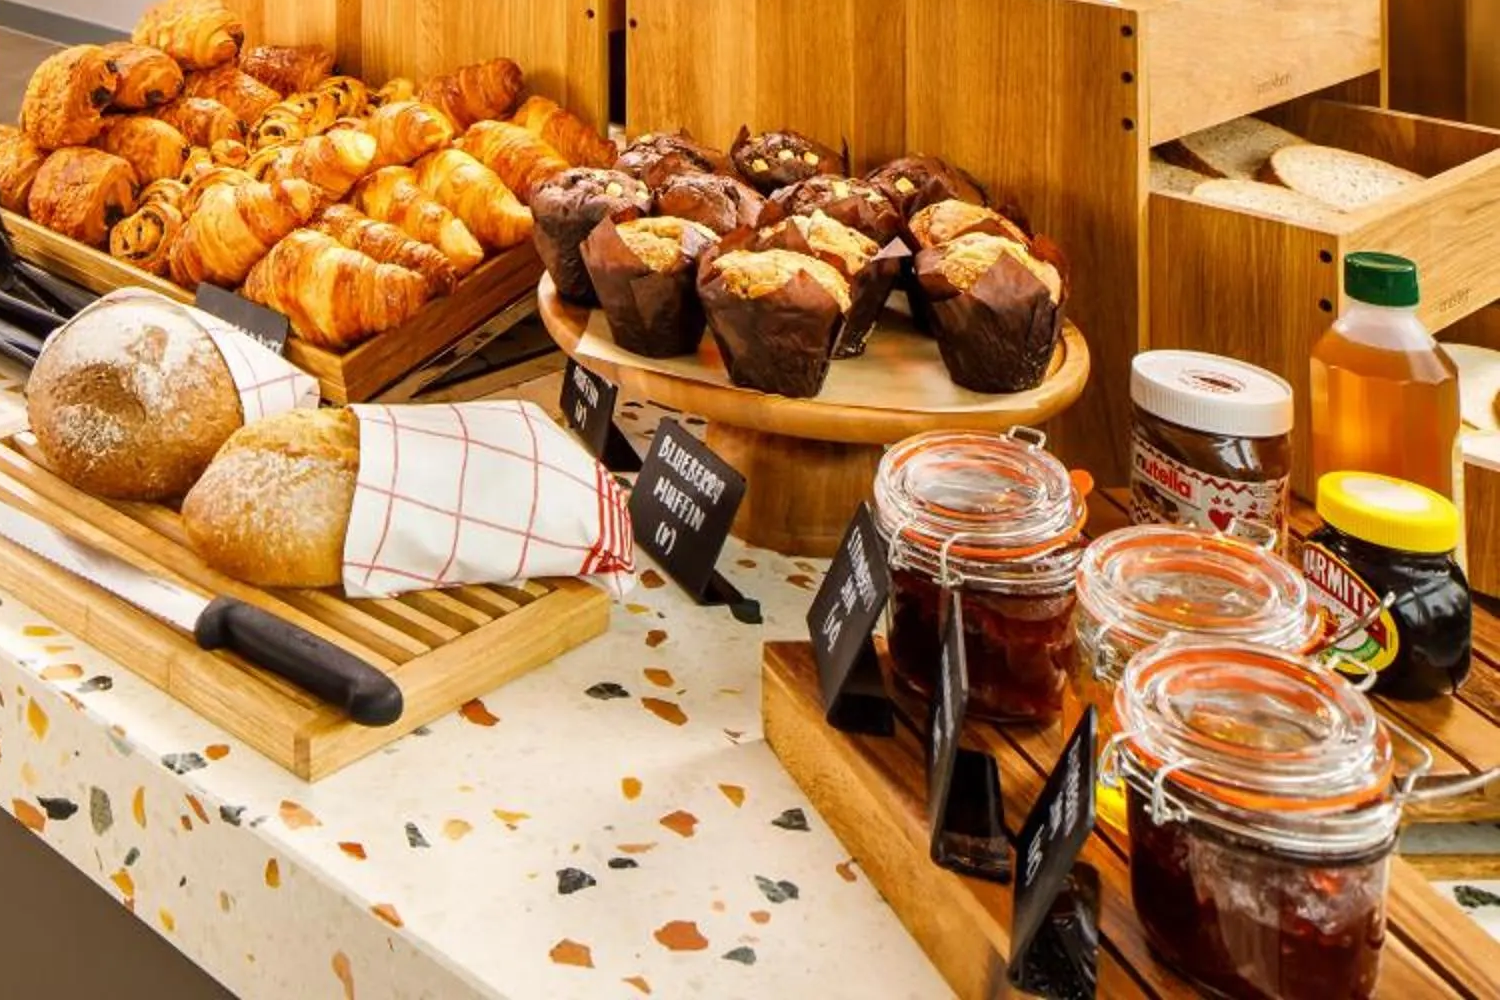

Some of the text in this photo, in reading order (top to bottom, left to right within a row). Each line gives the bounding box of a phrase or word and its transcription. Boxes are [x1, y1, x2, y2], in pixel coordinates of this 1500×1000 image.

[657, 433, 726, 505] BLUEBERRY
[1134, 453, 1192, 499] nutella
[653, 476, 706, 532] MUFFIN
